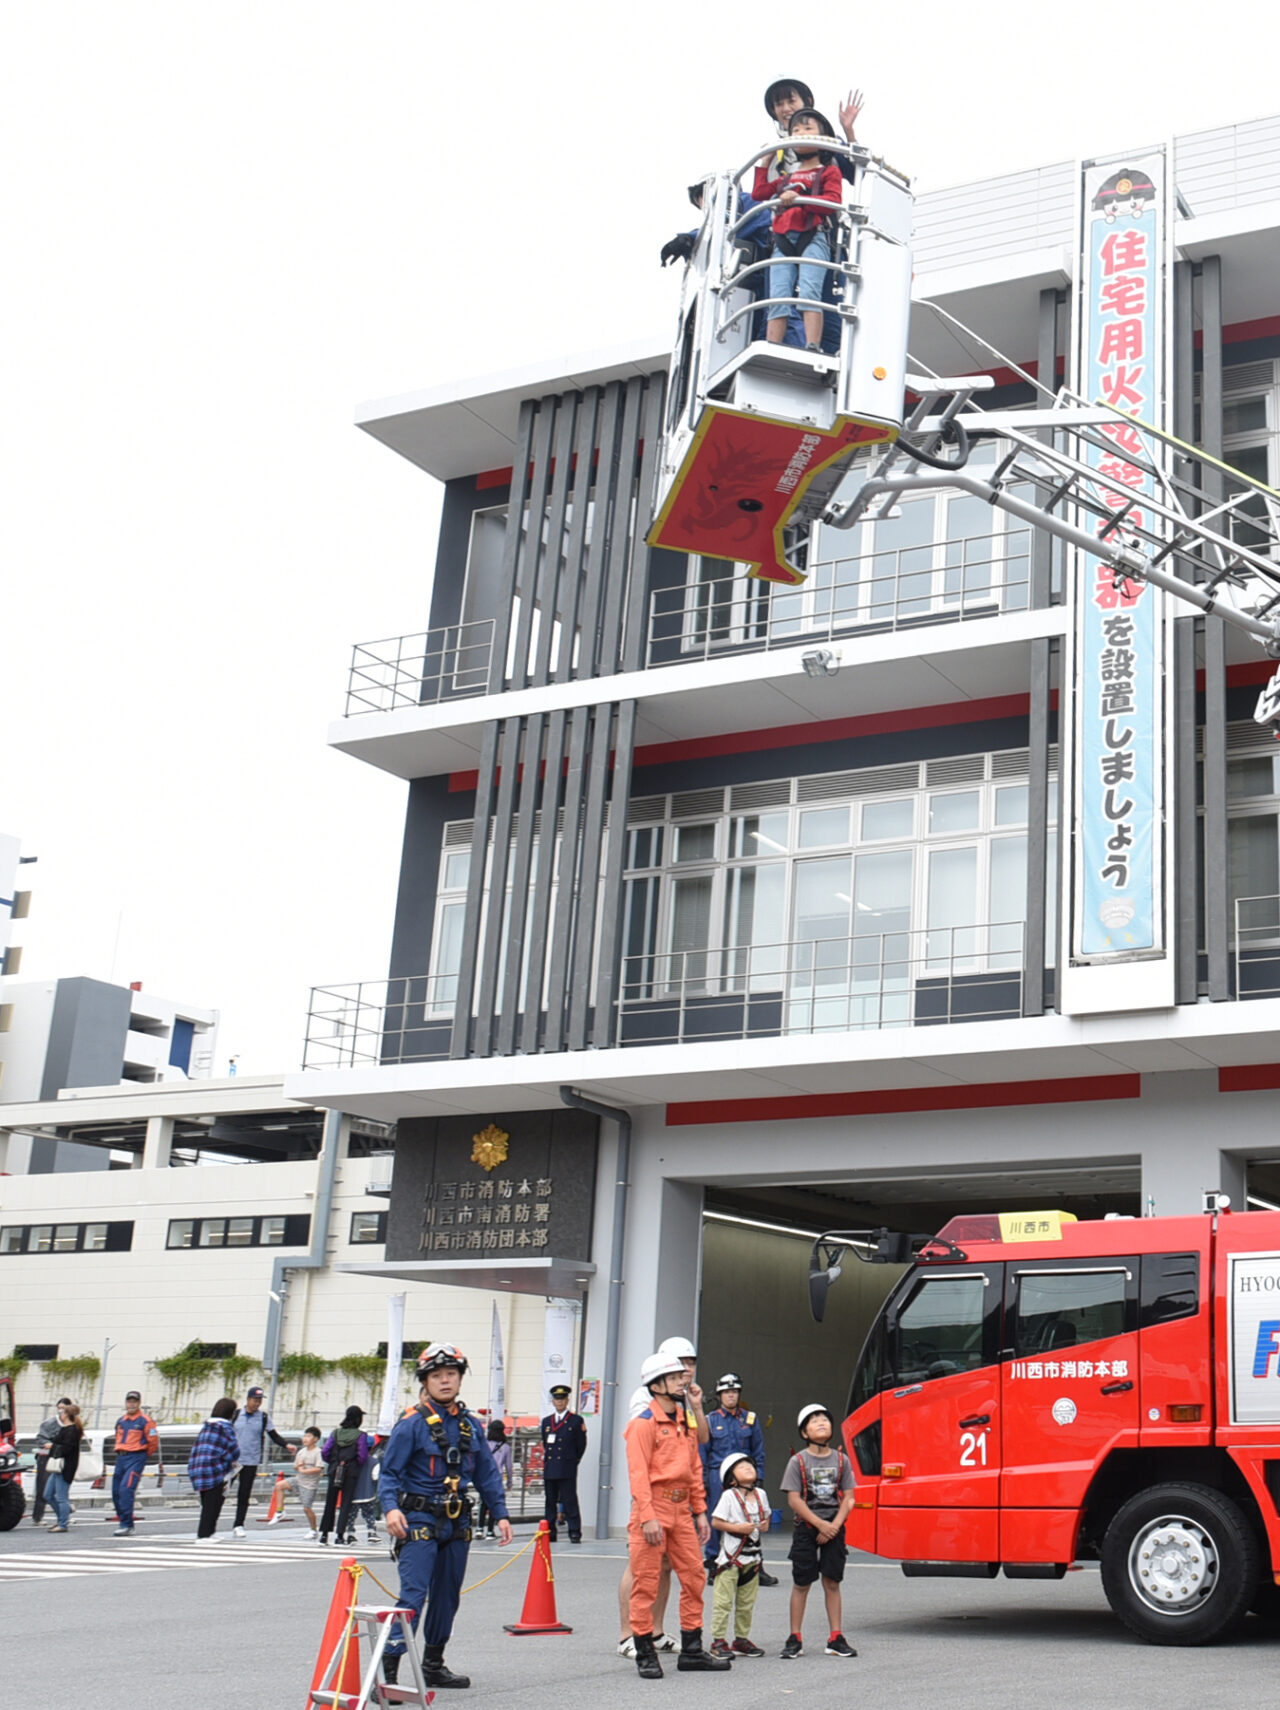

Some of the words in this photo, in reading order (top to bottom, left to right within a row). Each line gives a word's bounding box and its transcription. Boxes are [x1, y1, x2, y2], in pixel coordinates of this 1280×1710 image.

[424, 1178, 553, 1202] 川西市消防本部
[420, 1203, 551, 1227] 川西市南消防署
[1009, 1221, 1051, 1234] 川西市
[417, 1229, 548, 1251] 川西市消防団本部
[1011, 1360, 1128, 1380] 川西市消防本部
[960, 1432, 987, 1467] 21
